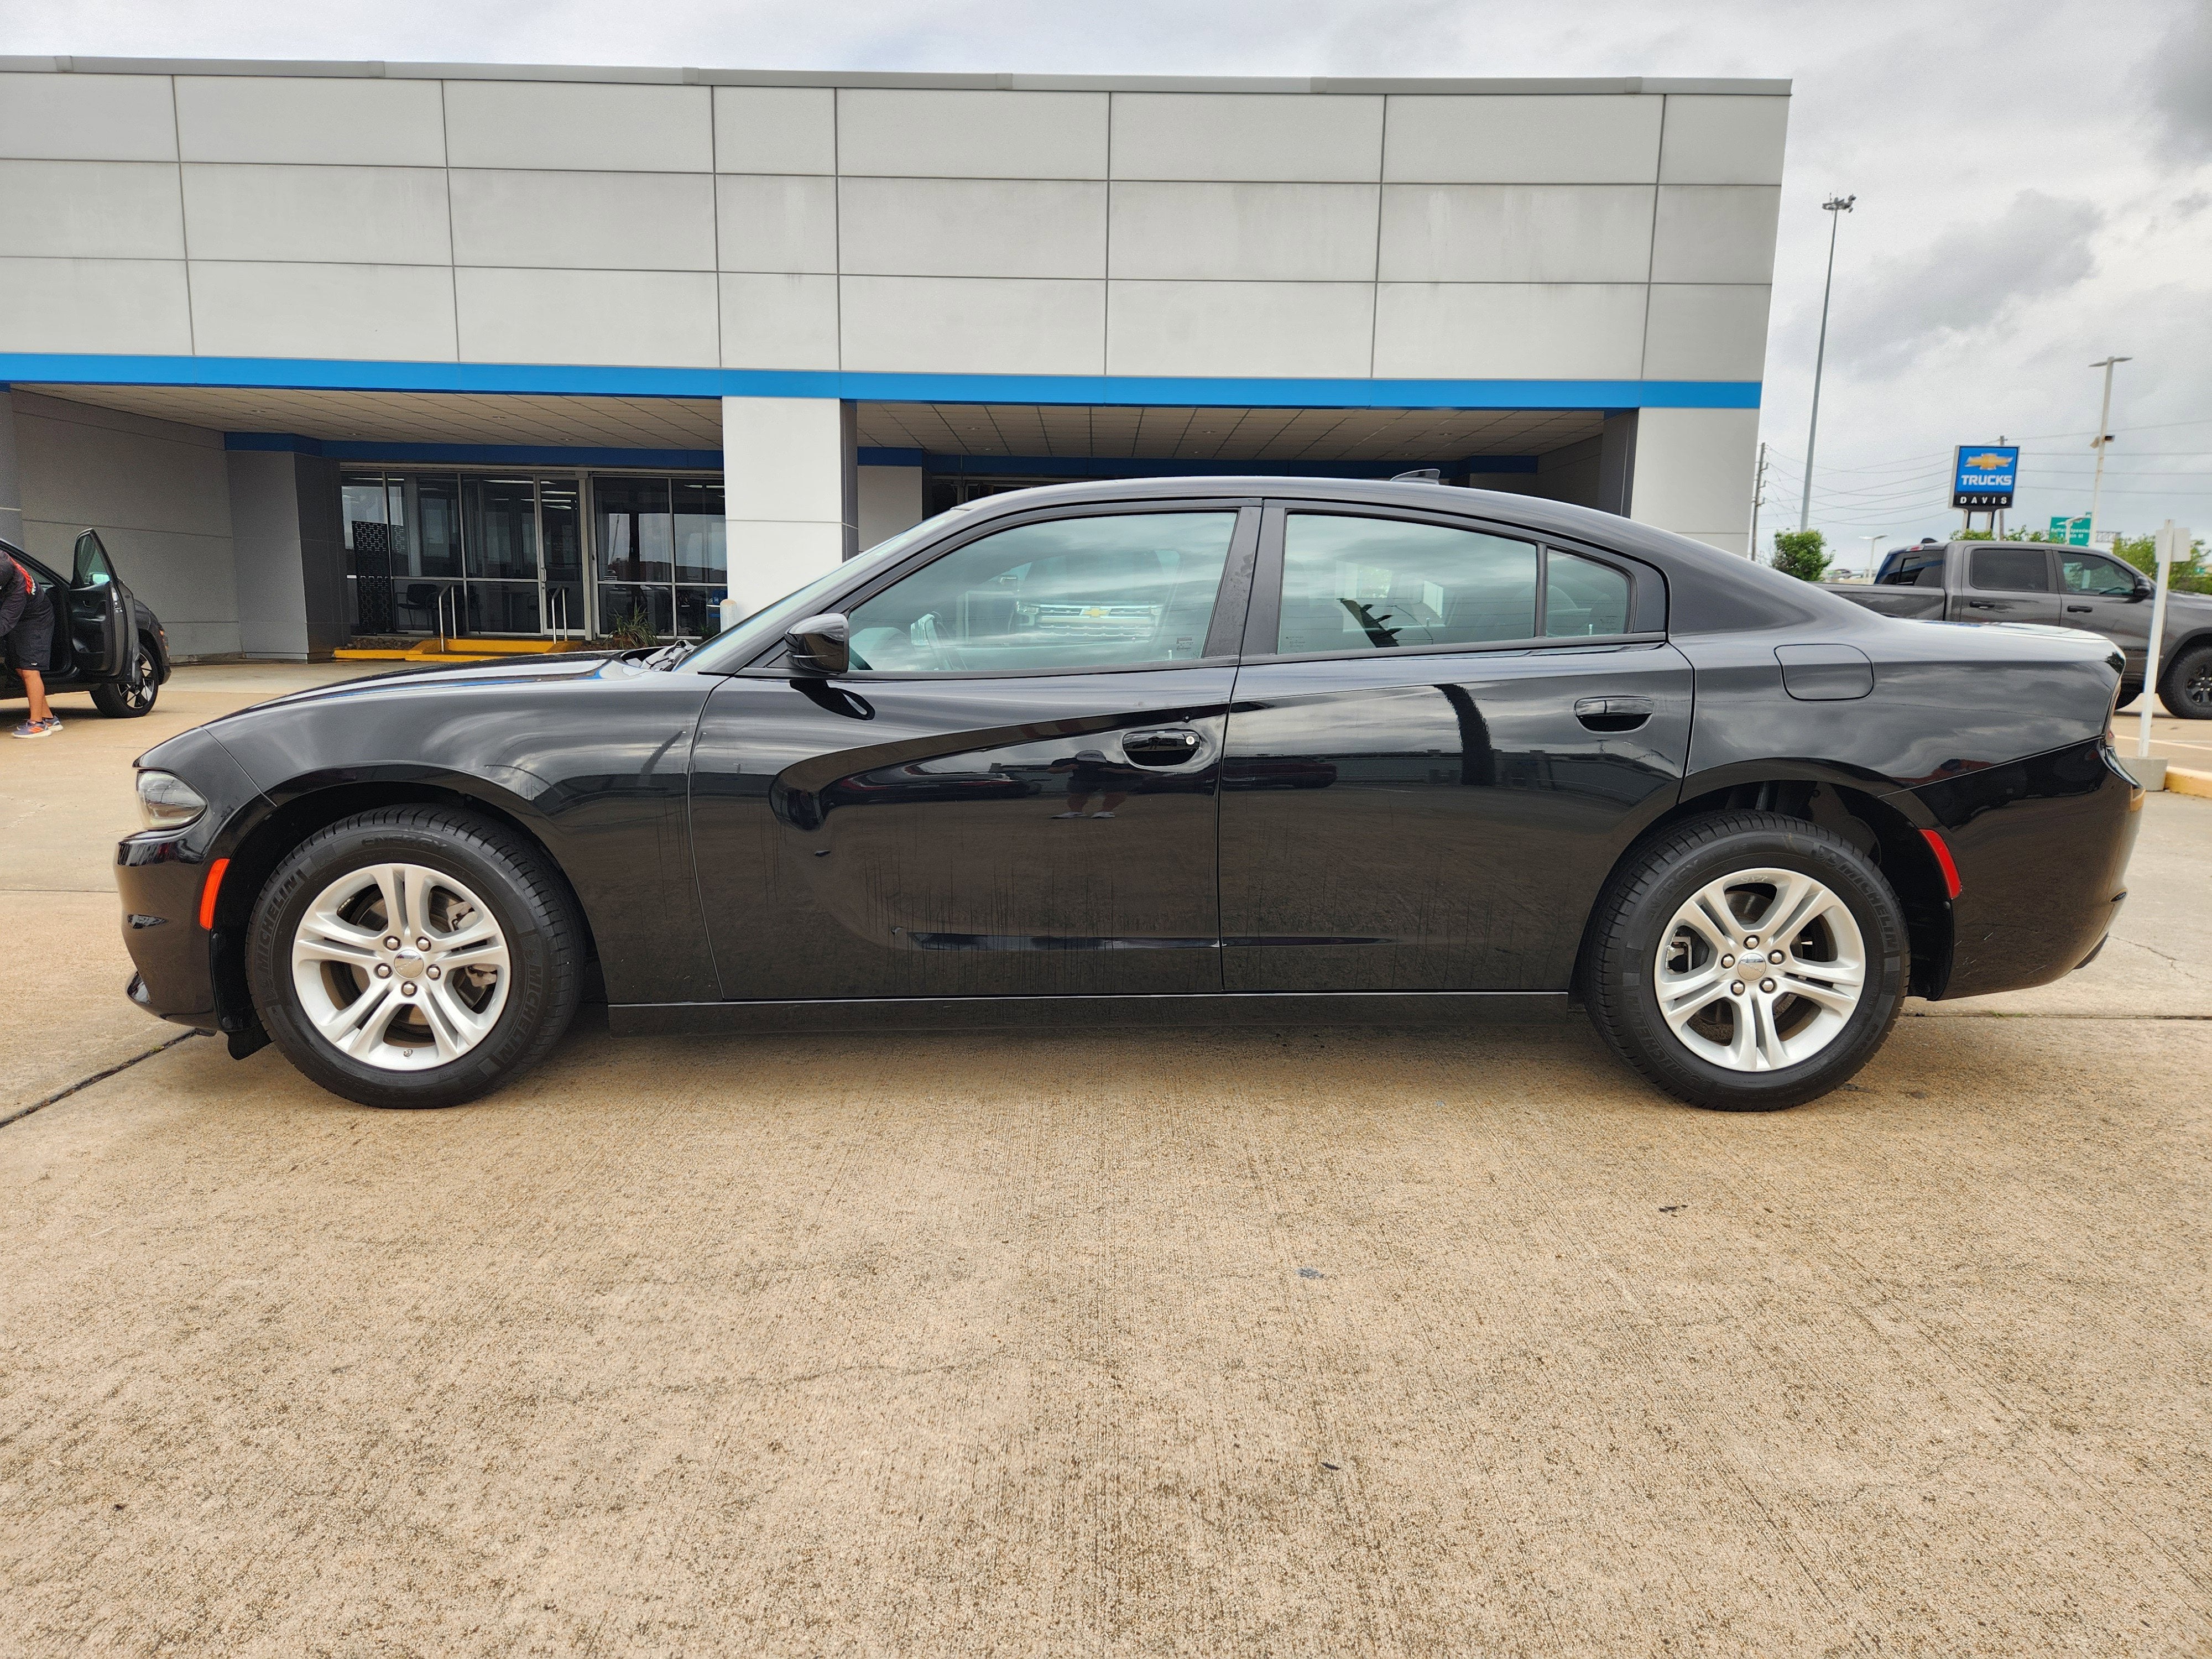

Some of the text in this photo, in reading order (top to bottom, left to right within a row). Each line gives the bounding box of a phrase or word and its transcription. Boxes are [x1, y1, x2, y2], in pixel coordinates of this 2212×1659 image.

[1961, 474, 2012, 486] TRUCKS
[256, 869, 304, 974] MICHELIN
[1836, 861, 1901, 953] MICHELIN
[492, 963, 543, 1063] MICHELIN
